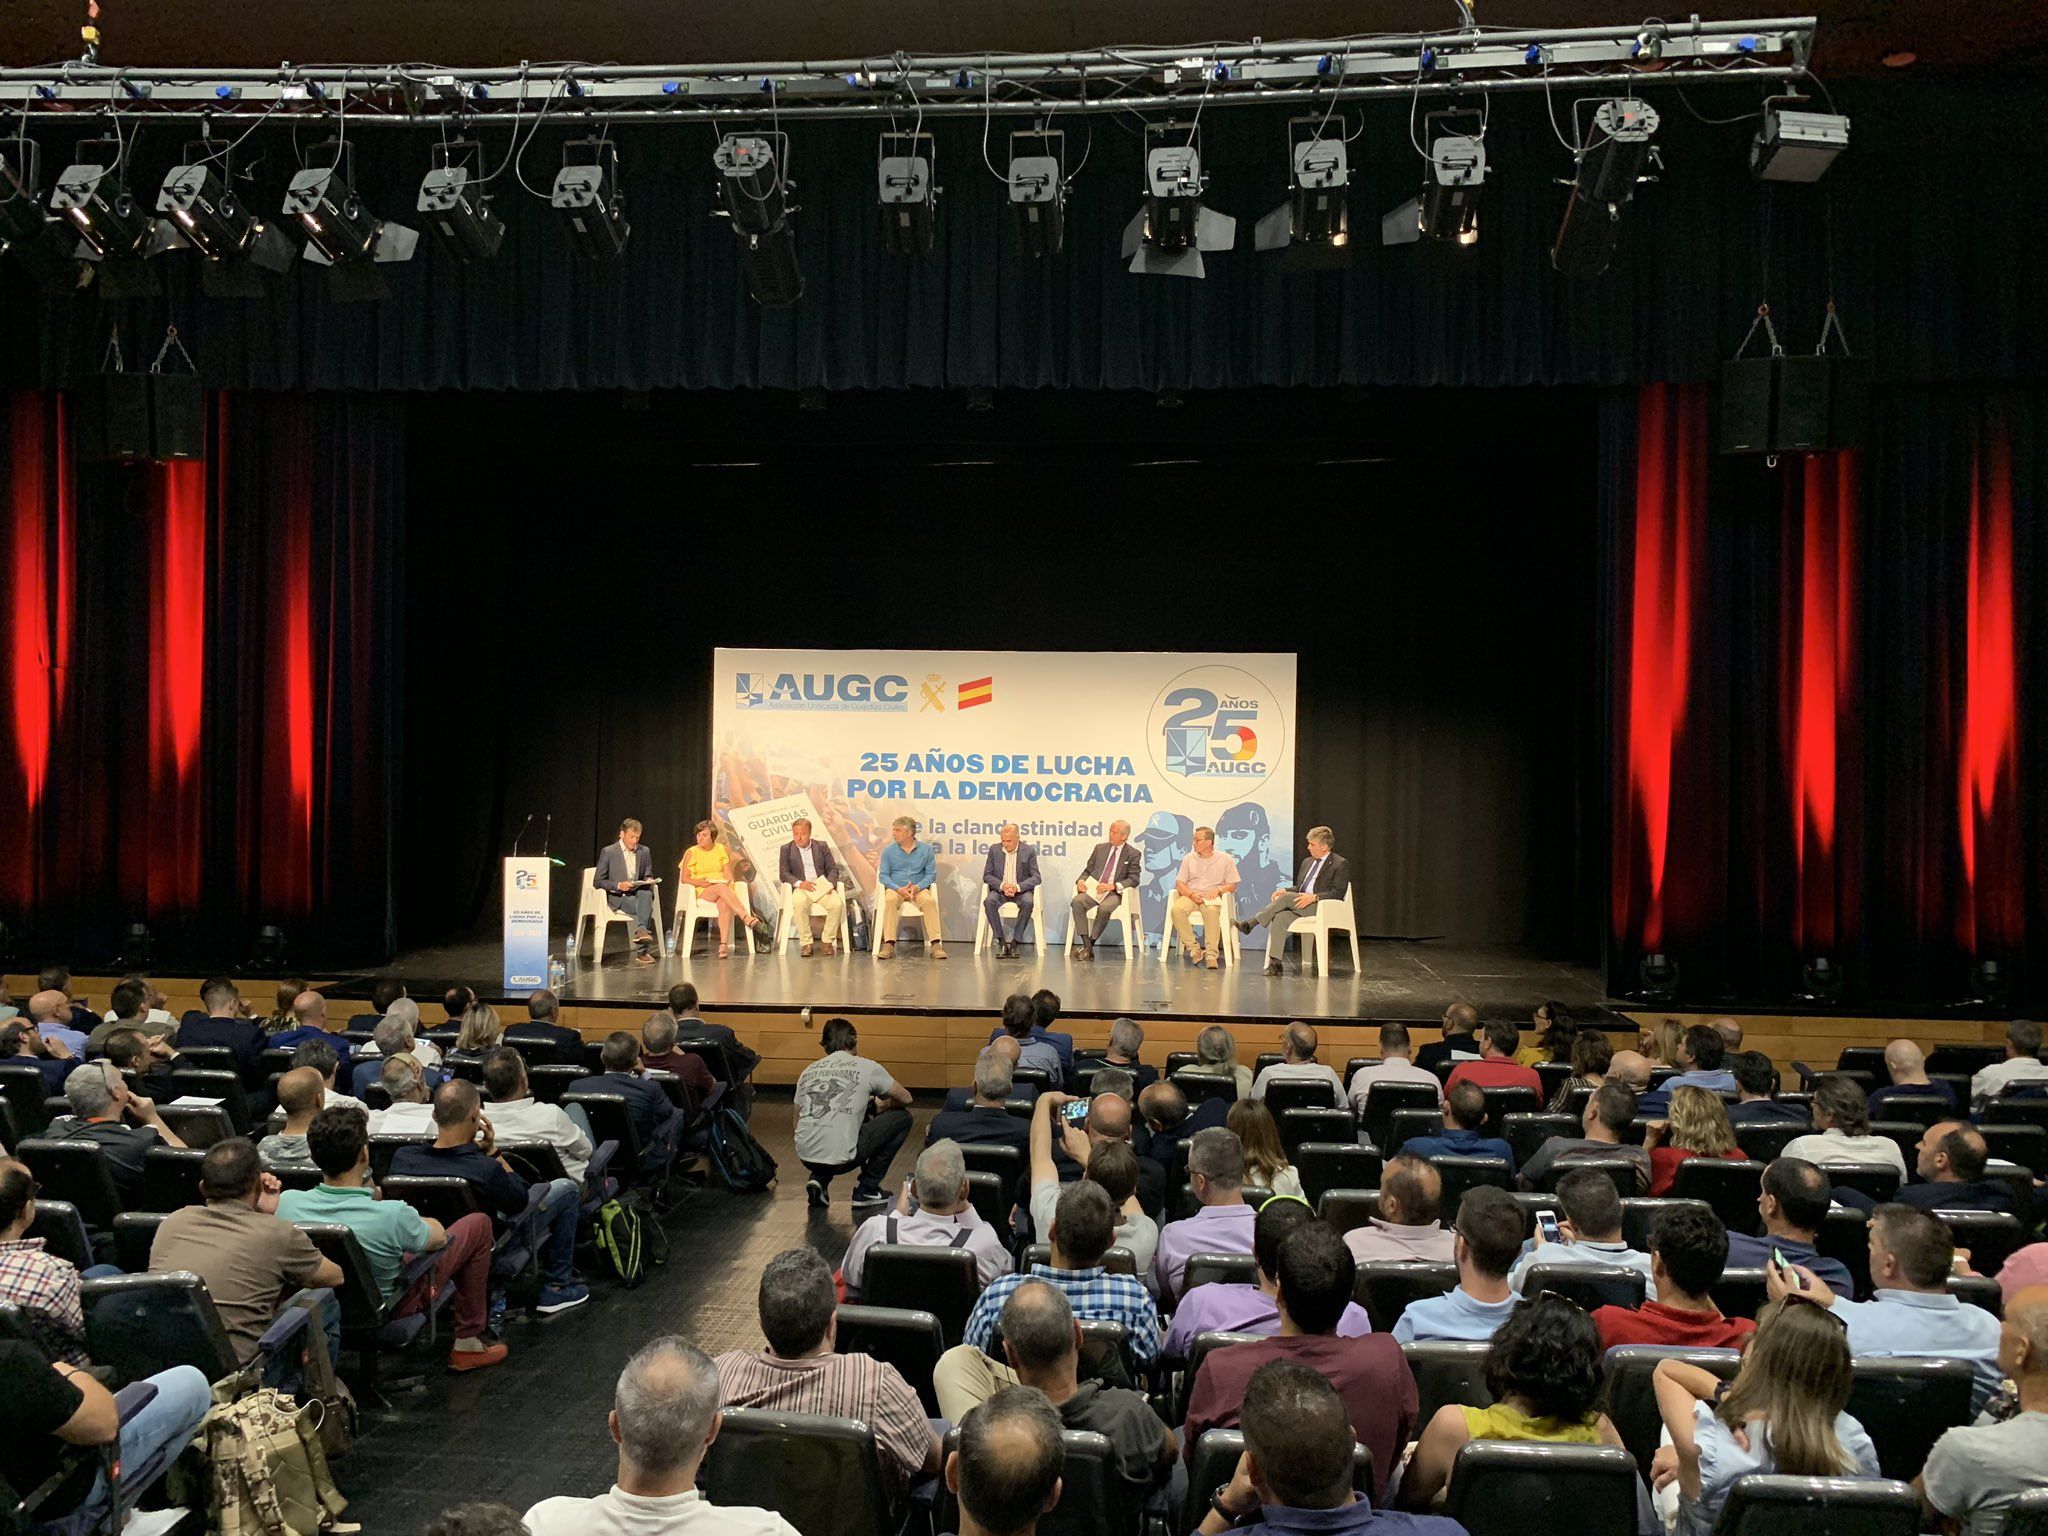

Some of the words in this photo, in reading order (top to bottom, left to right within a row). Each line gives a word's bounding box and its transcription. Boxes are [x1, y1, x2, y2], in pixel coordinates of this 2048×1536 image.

[769, 673, 908, 702] AUGC
[1219, 693, 1259, 709] AÑOS
[860, 752, 899, 772] 25
[904, 747, 984, 773] AÑOS
[991, 754, 1029, 774] DE
[1037, 754, 1136, 776] LUCHA
[1206, 761, 1266, 774] AUGC
[847, 779, 907, 799] POR
[913, 779, 951, 800] LA
[958, 780, 1154, 804] DEMOCRACIA
[748, 808, 809, 830] GUARDIAS
[929, 818, 946, 834] la
[953, 818, 1103, 838] clandstinidad
[932, 842, 942, 854] a
[948, 838, 966, 855] la
